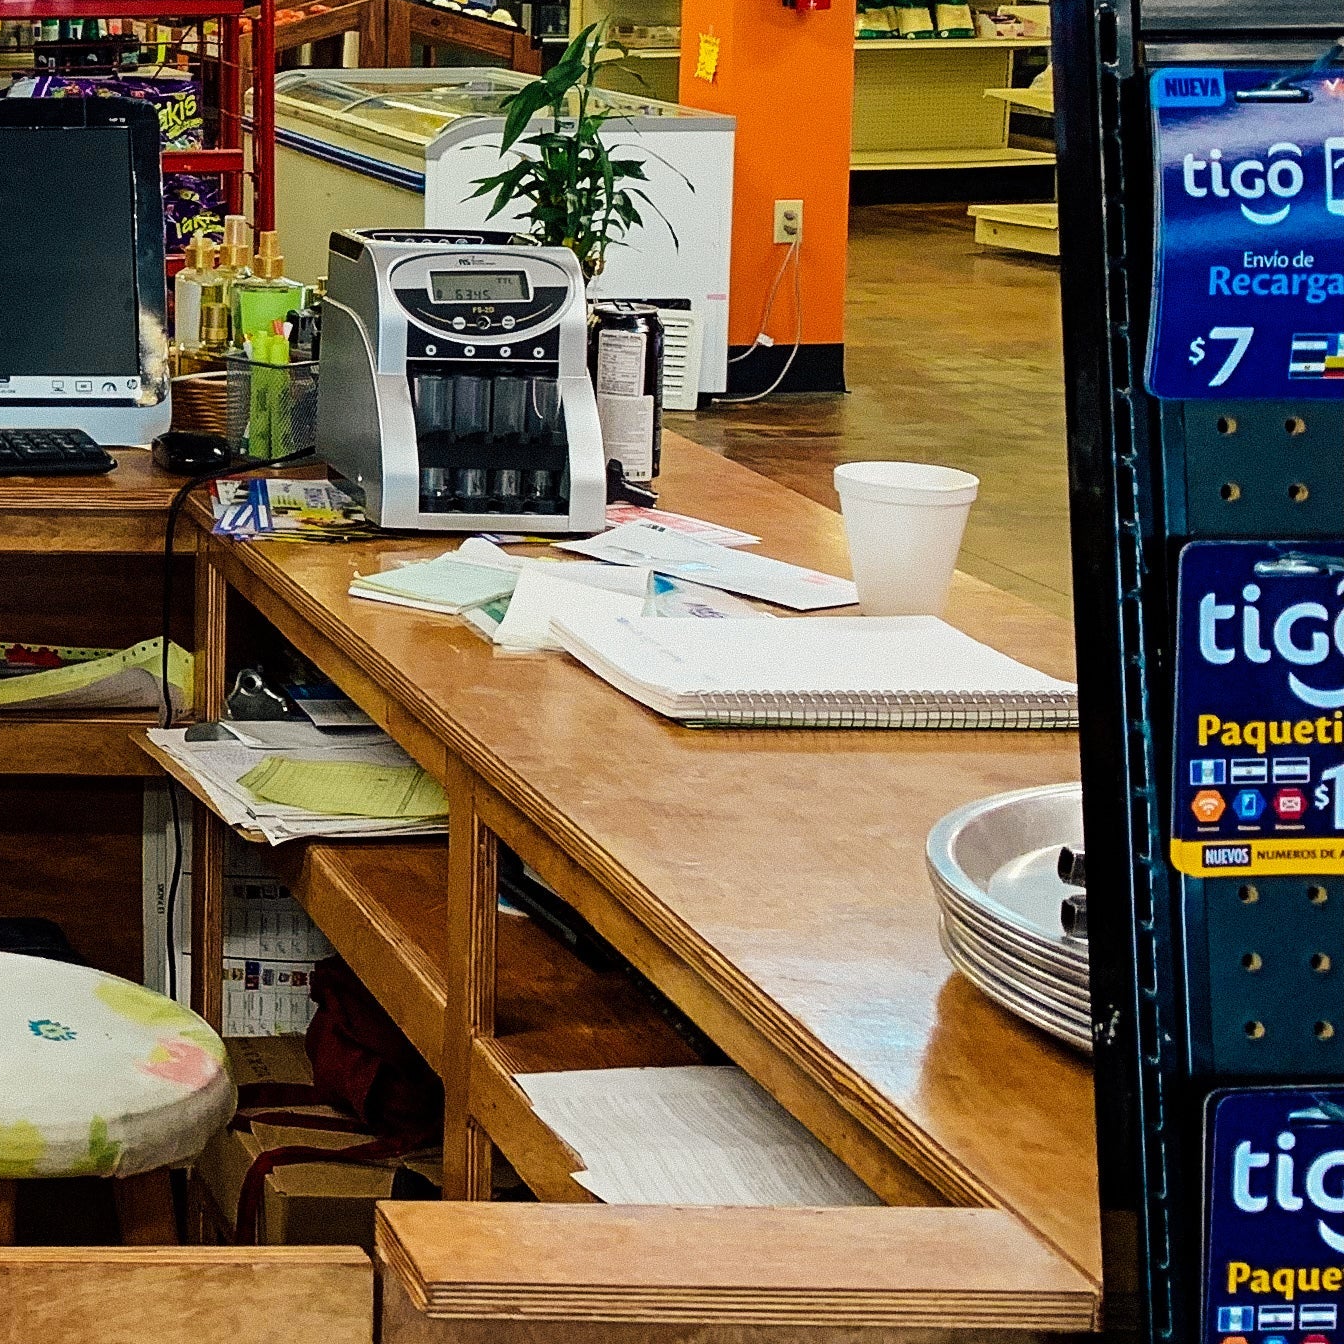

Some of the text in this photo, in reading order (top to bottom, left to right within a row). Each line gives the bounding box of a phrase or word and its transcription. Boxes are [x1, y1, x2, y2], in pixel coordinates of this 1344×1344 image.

[1165, 77, 1222, 98] NUEVA
[155, 95, 197, 130] akis
[1183, 143, 1304, 218] tigo
[1243, 250, 1314, 269] Envío de
[1188, 326, 1255, 387] $7
[1199, 582, 1344, 694] tig
[1205, 847, 1334, 865] NUEVOS NUMEROS DE
